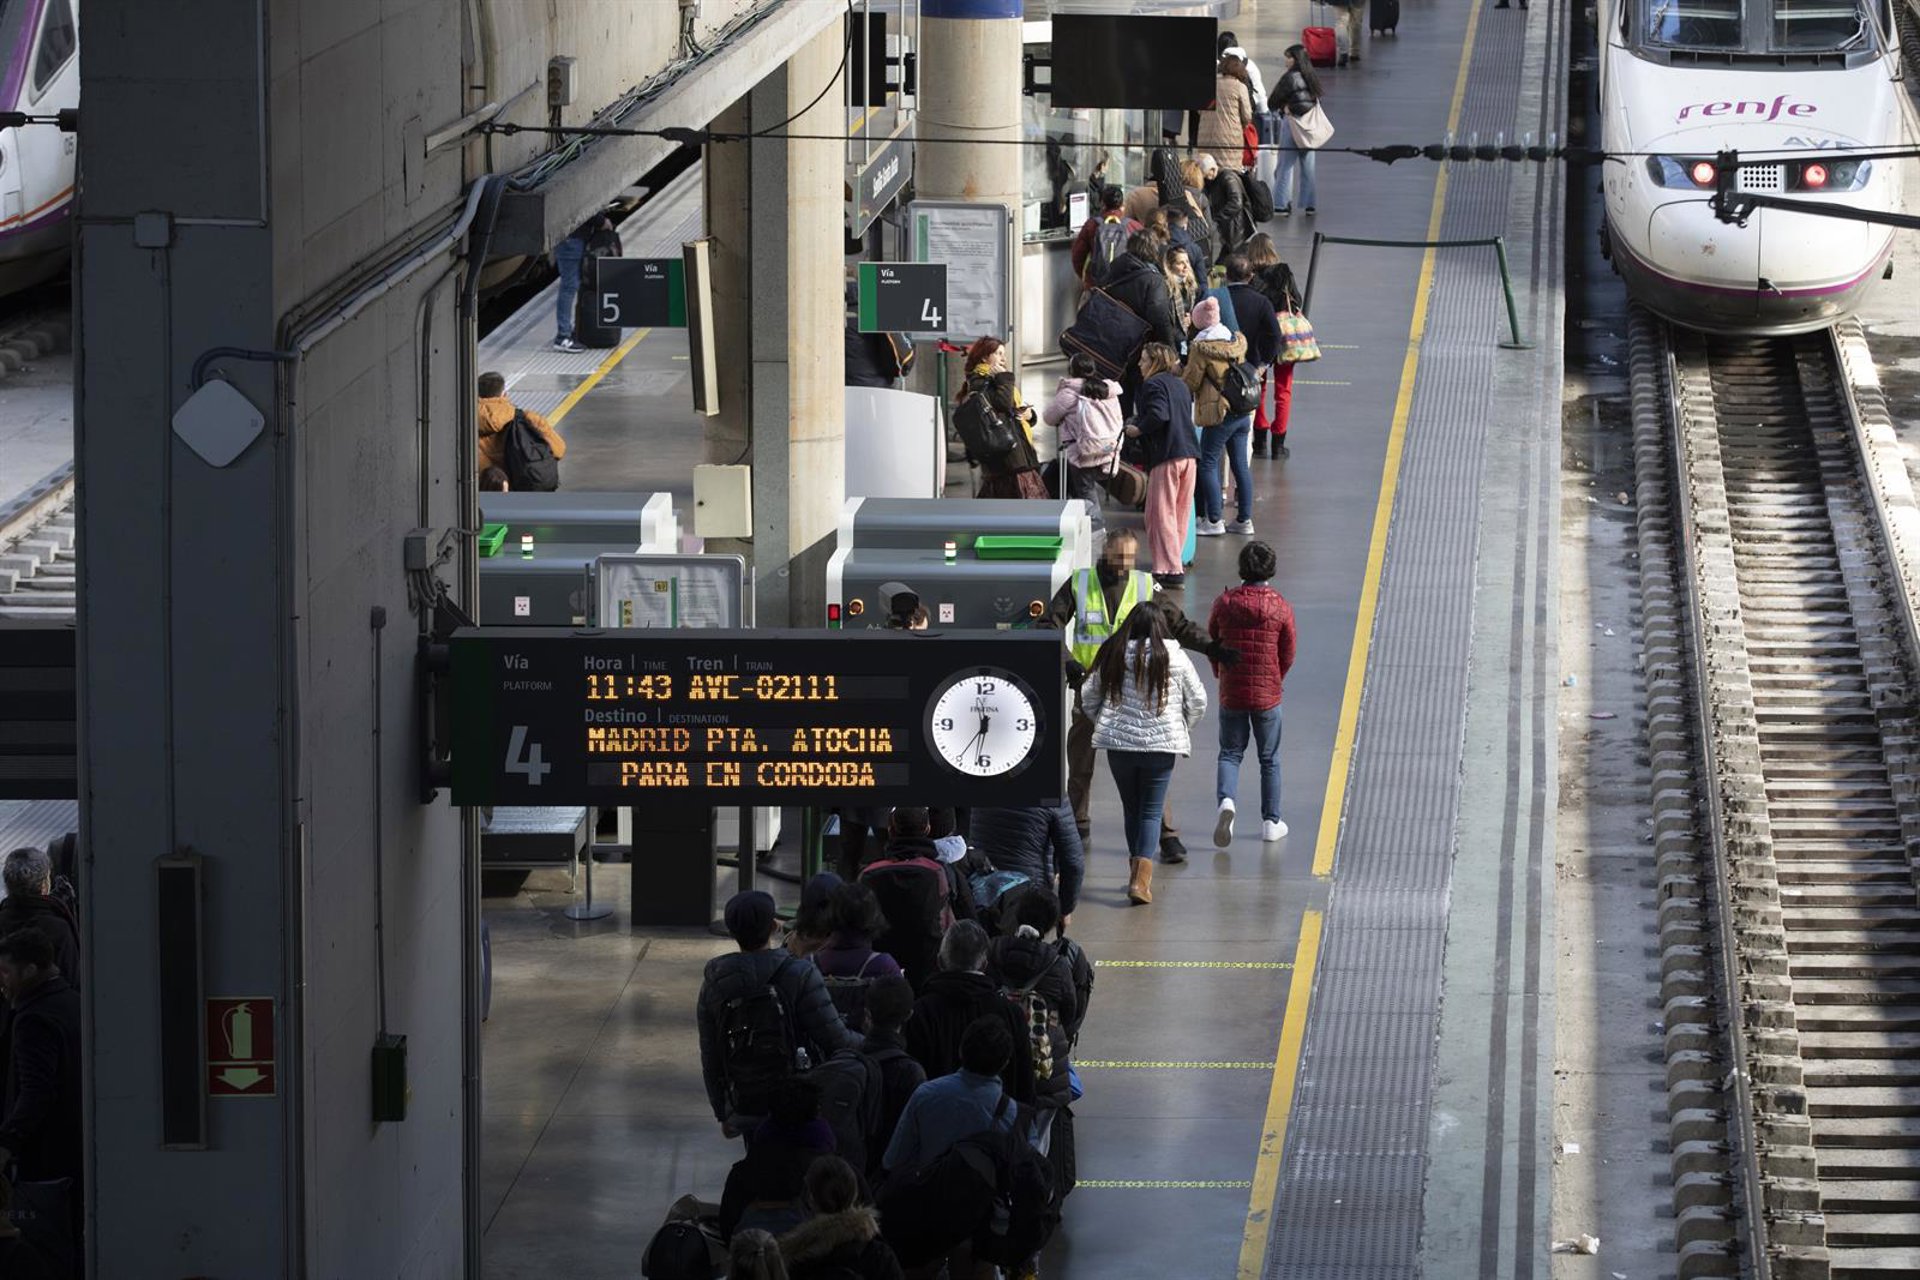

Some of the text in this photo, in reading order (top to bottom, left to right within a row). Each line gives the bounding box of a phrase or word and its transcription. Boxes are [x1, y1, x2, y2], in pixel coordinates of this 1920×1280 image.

[1677, 95, 1817, 124] renfe
[1783, 136, 1854, 153] AVE
[644, 263, 658, 272] Vía
[881, 268, 895, 277] Vía
[603, 293, 620, 323] 5
[921, 298, 942, 328] 4
[504, 654, 529, 669] Vía
[584, 655, 666, 670] Hora TIME
[687, 656, 773, 671] Tren TRAIN
[504, 681, 552, 690] PLATFORM
[587, 674, 672, 699] 11:43
[976, 682, 995, 695] 12
[585, 708, 729, 724] Destino DESTINATION
[941, 718, 953, 731] 9
[1016, 718, 1028, 731] 3
[588, 728, 893, 752] MADRID PTA. ATOCHA
[504, 726, 551, 785] 4
[979, 755, 991, 767] 6
[622, 762, 690, 787] PARA
[757, 762, 875, 787] CORDOBA
